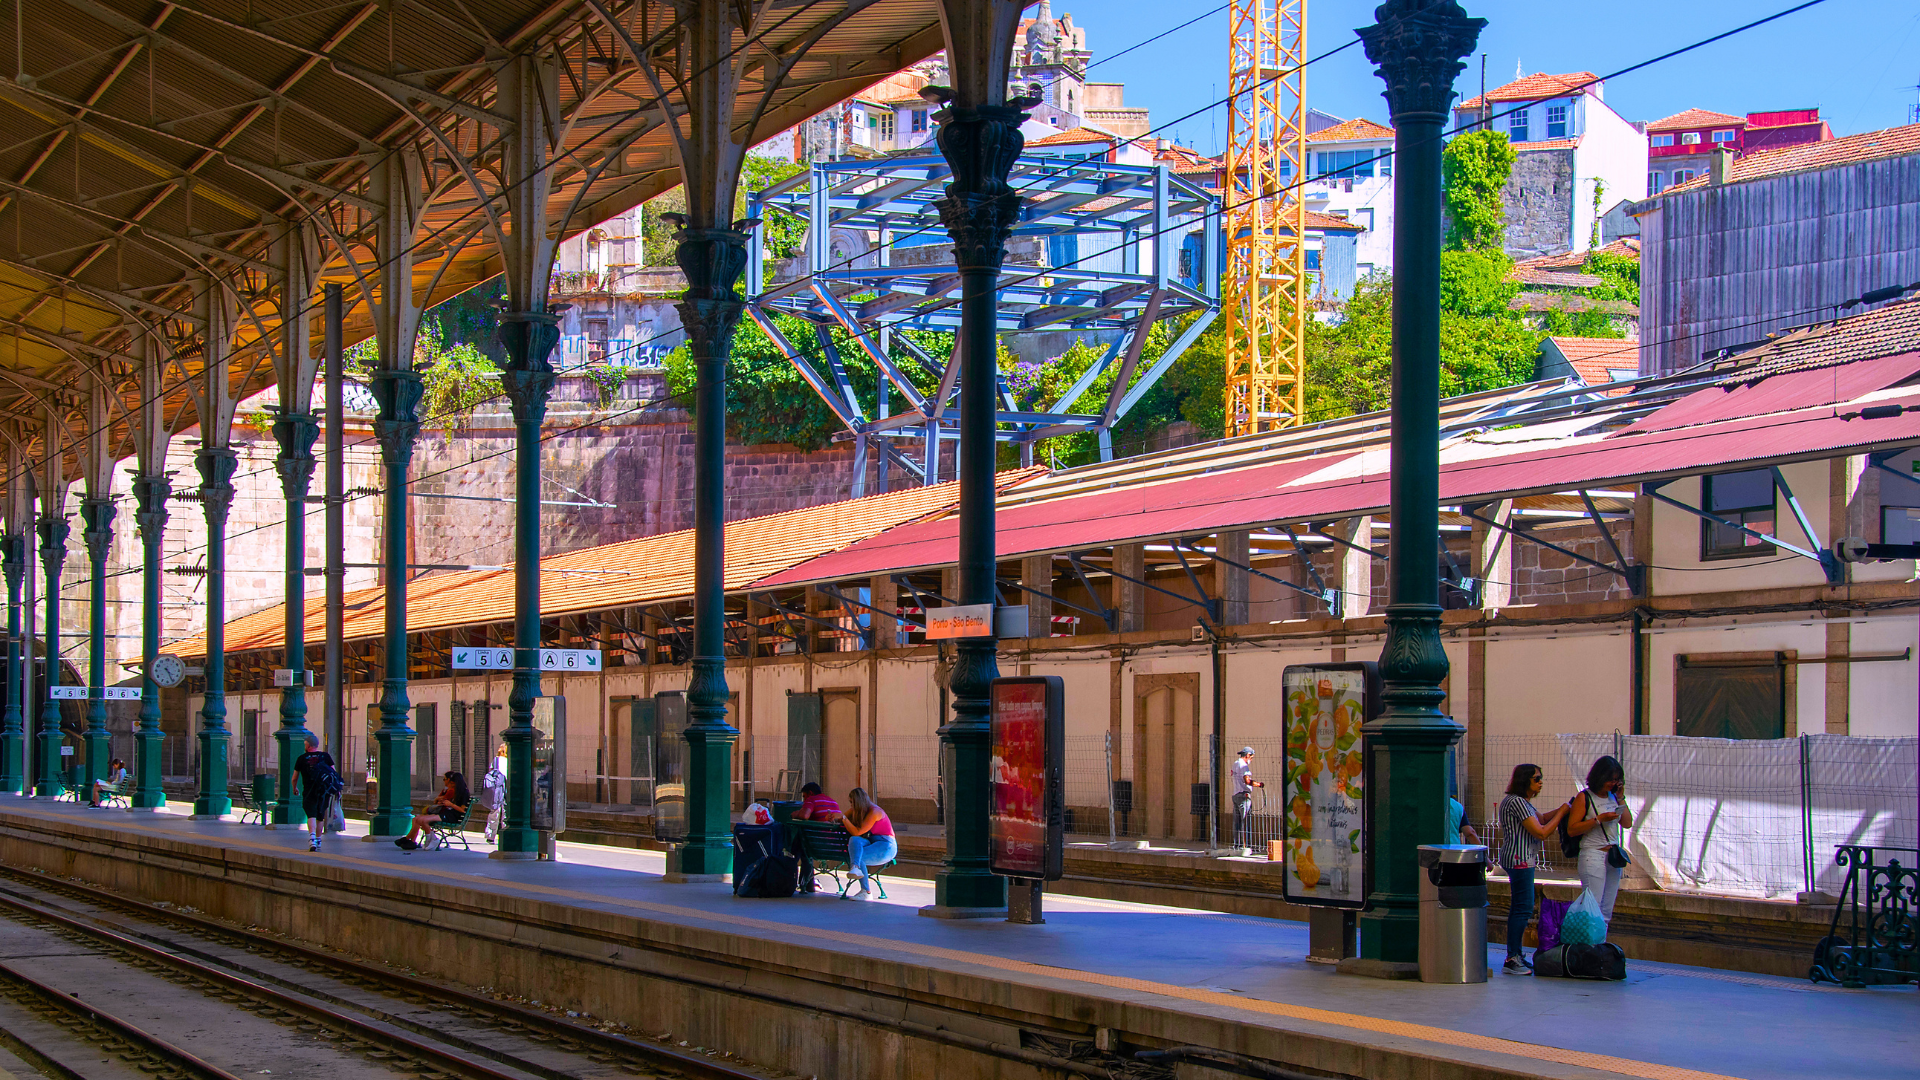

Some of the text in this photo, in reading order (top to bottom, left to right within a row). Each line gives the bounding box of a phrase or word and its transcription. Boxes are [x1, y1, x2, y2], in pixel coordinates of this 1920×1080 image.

[932, 618, 948, 629] Porto
[953, 616, 964, 628] São
[965, 615, 984, 627] Bento
[480, 655, 487, 666] 5
[499, 653, 509, 664] A
[545, 654, 555, 665] A
[567, 656, 574, 667] 6
